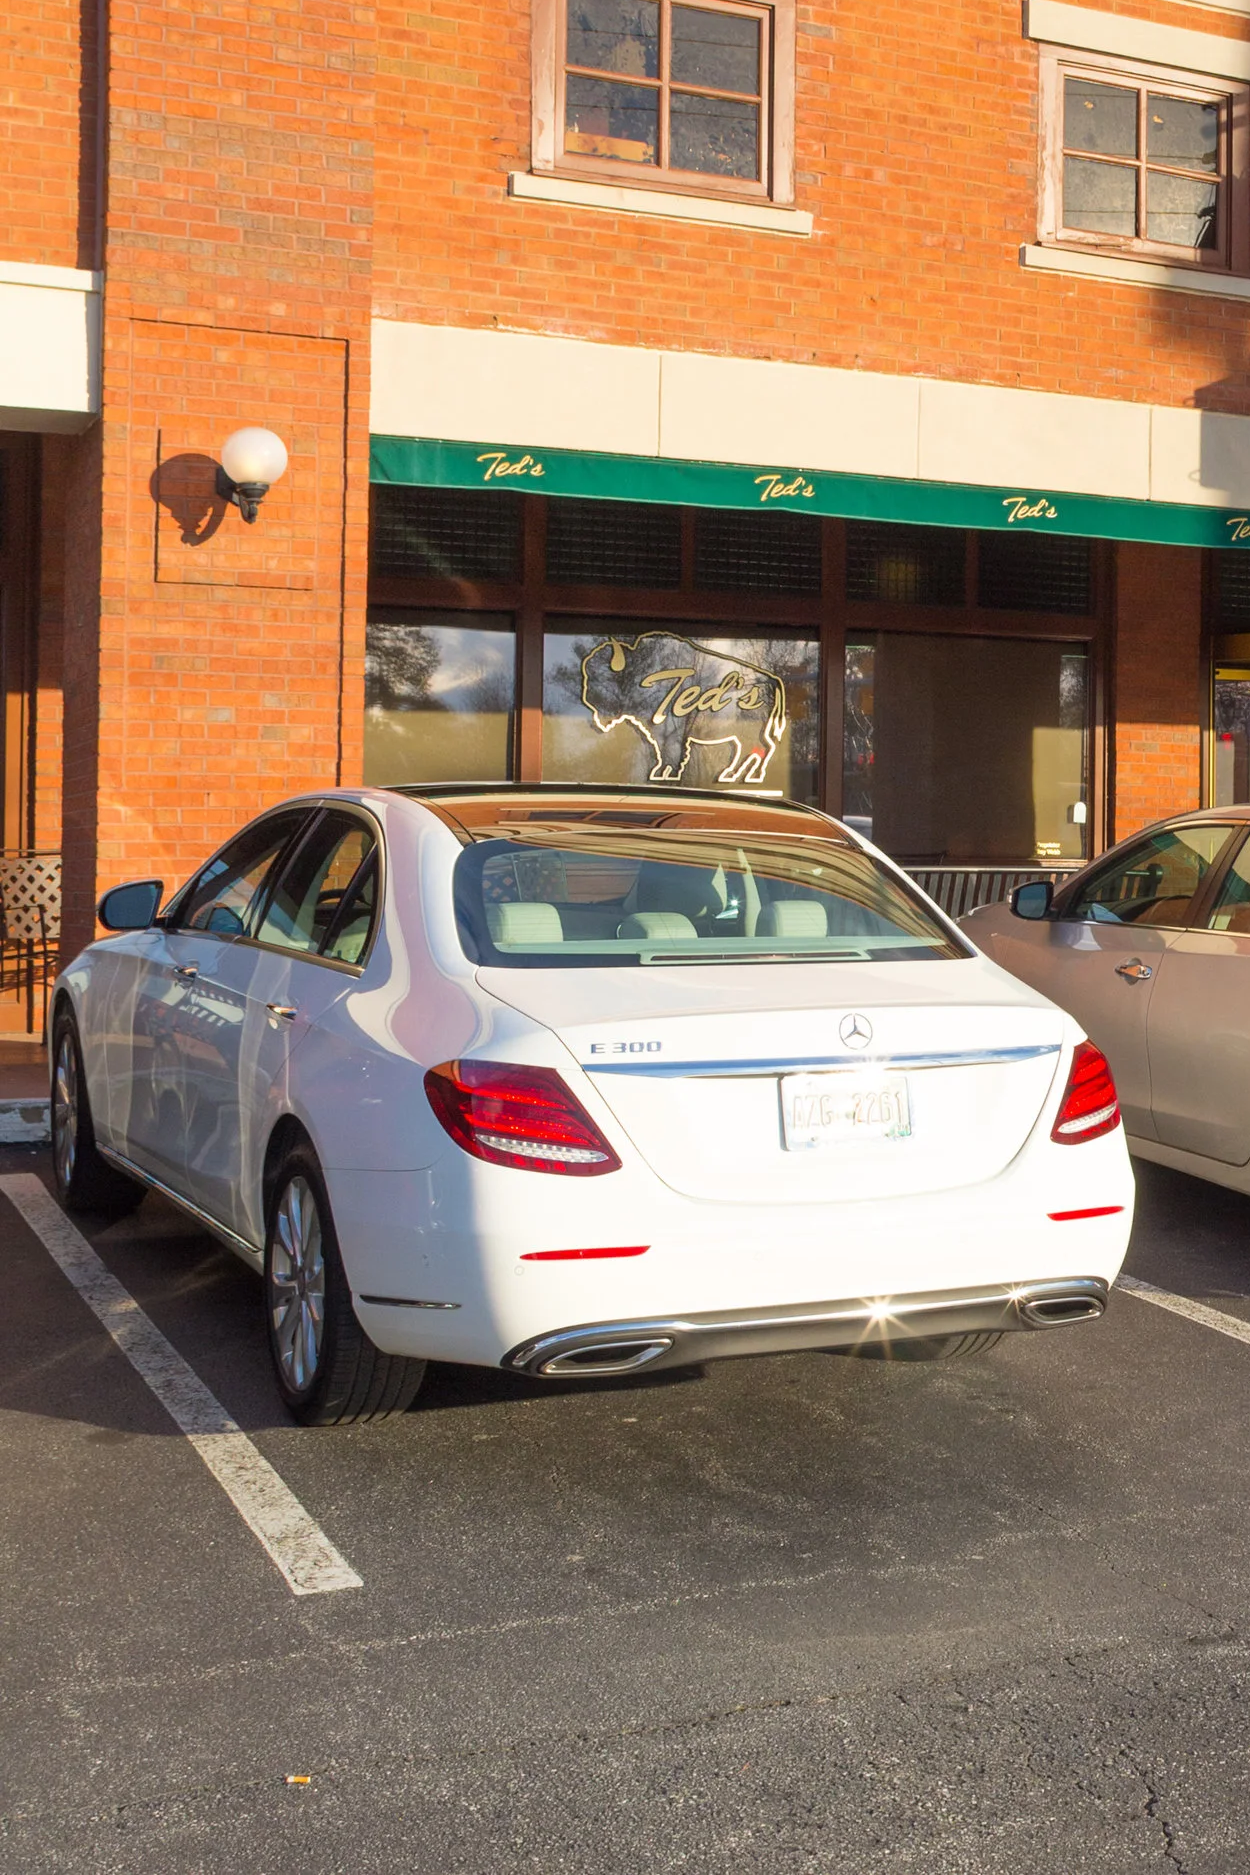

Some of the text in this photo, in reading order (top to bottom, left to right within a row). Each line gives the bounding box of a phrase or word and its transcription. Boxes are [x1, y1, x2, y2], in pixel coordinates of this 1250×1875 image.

[476, 452, 545, 482] Ted's
[754, 474, 815, 502] Ted's
[1002, 497, 1057, 524] Ted's
[640, 668, 764, 725] Ted's
[590, 1041, 662, 1054] E 300
